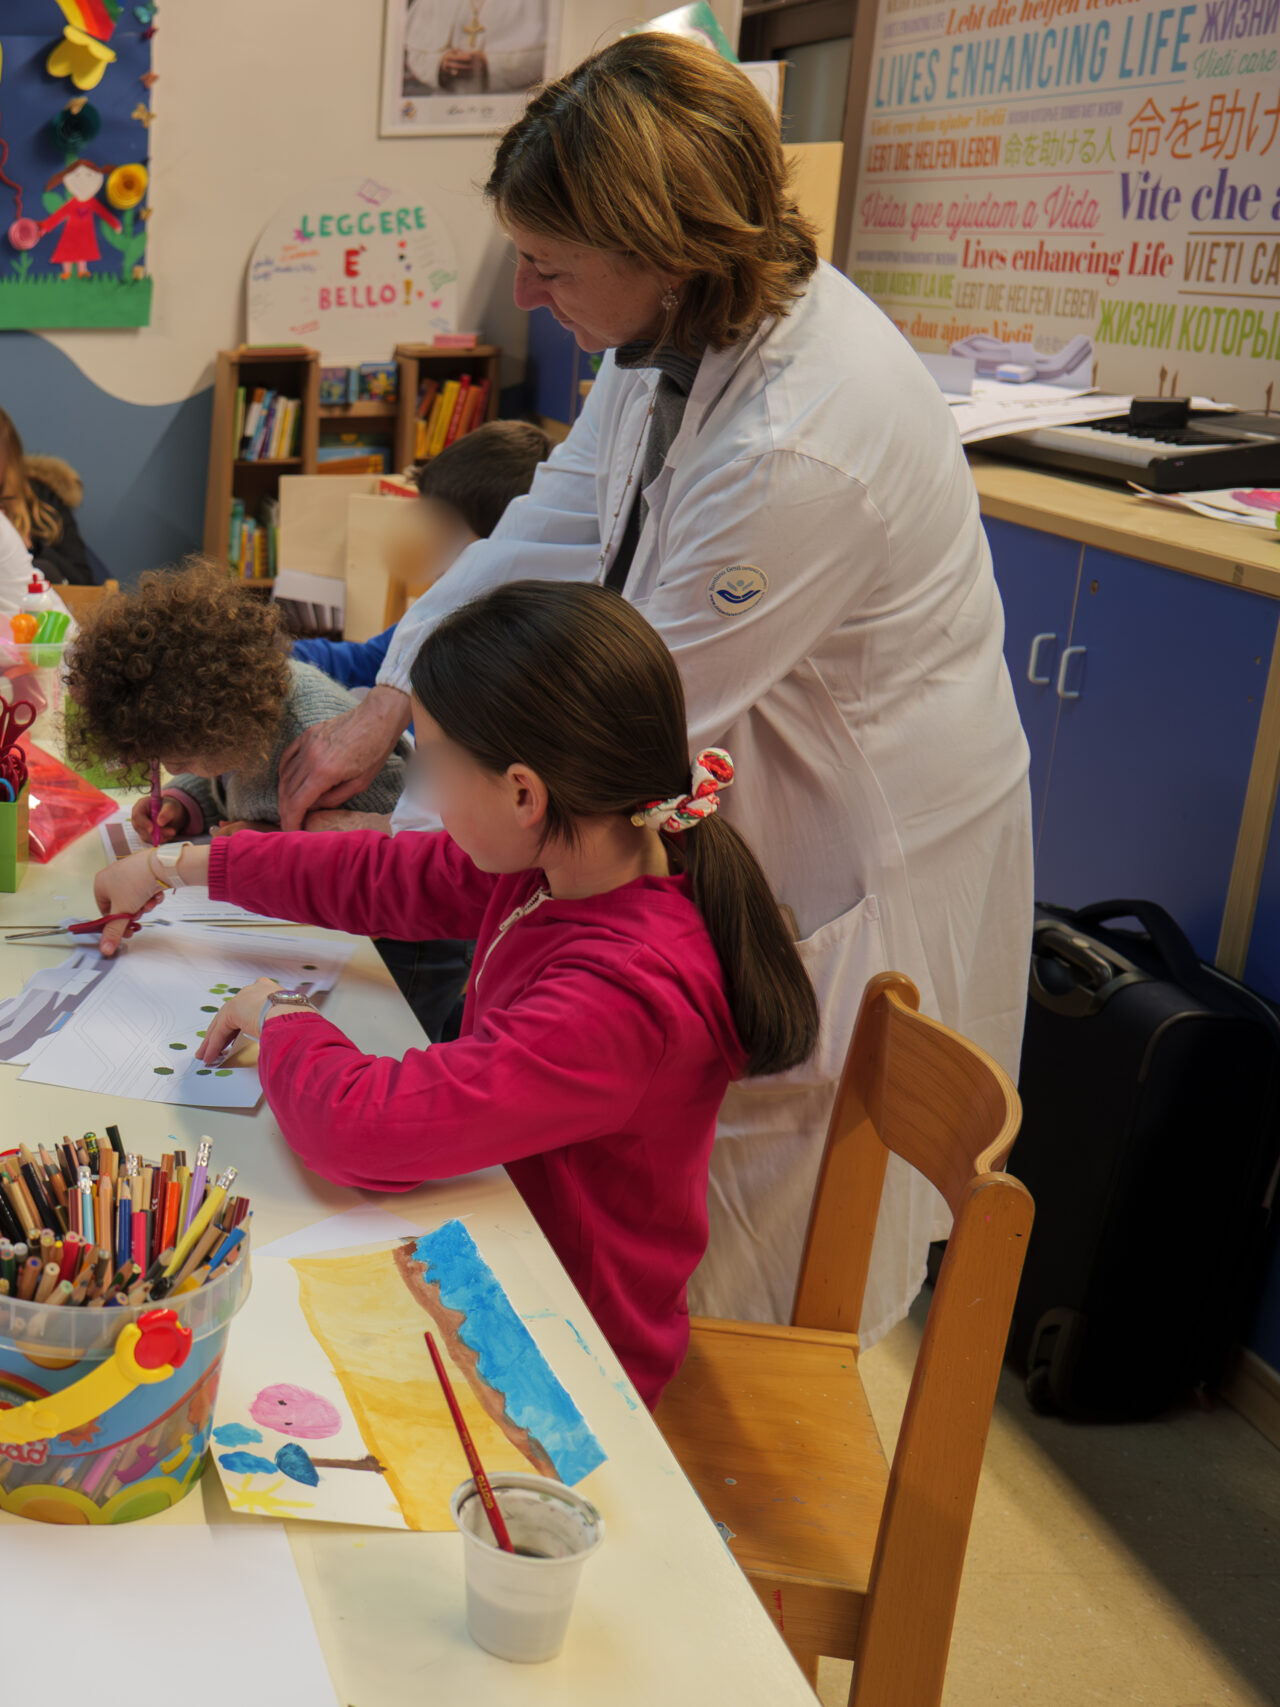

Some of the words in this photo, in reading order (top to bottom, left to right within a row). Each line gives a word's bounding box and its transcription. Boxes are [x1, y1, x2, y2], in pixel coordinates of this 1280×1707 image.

[874, 48, 940, 108] LIVES
[945, 19, 1110, 99] ENHANCING
[1118, 5, 1197, 79] LIFE
[914, 138, 959, 171] HELFEN
[960, 135, 1001, 168] LEBEN
[910, 200, 943, 242] que
[1043, 184, 1103, 230] Vida
[1120, 168, 1182, 221] Vite
[1191, 167, 1262, 221] che
[962, 238, 1007, 270] Lives
[1011, 239, 1123, 287] enhancing
[1128, 241, 1174, 279] Life
[1183, 241, 1245, 285] VIETI
[1006, 283, 1055, 317] HELFEN
[1054, 287, 1099, 320] LEBEN
[1095, 298, 1176, 351] ЖИЗНИ
[1177, 304, 1280, 361] КОТОРЫ
[475, 1474, 494, 1510] GIOTTO
